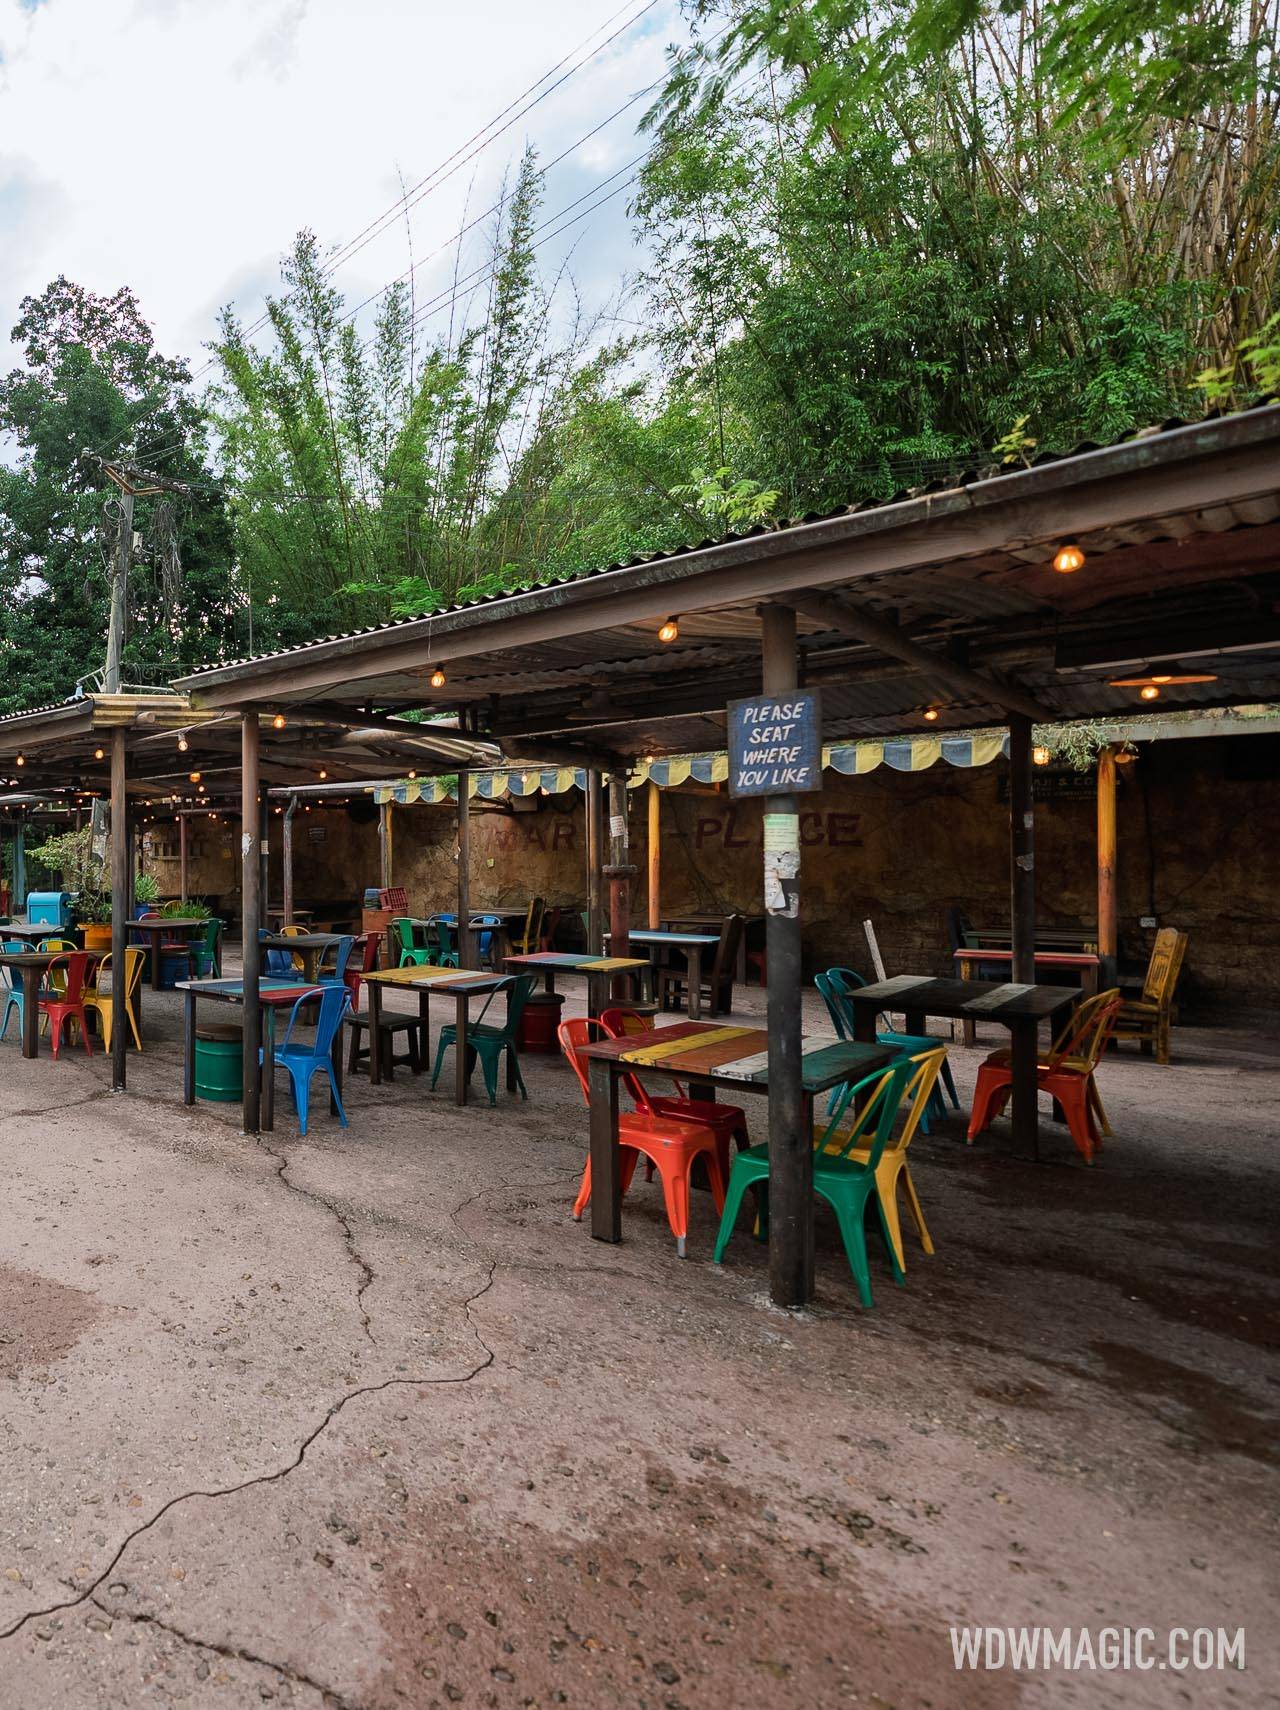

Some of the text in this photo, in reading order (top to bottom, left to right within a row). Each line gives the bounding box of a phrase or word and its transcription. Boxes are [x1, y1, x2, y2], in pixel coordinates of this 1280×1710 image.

[744, 702, 805, 724] PLEASE
[749, 724, 795, 744] SEAT
[743, 746, 802, 766] WHERE
[737, 767, 810, 788] YOU LIKE
[695, 808, 864, 851] PLCE
